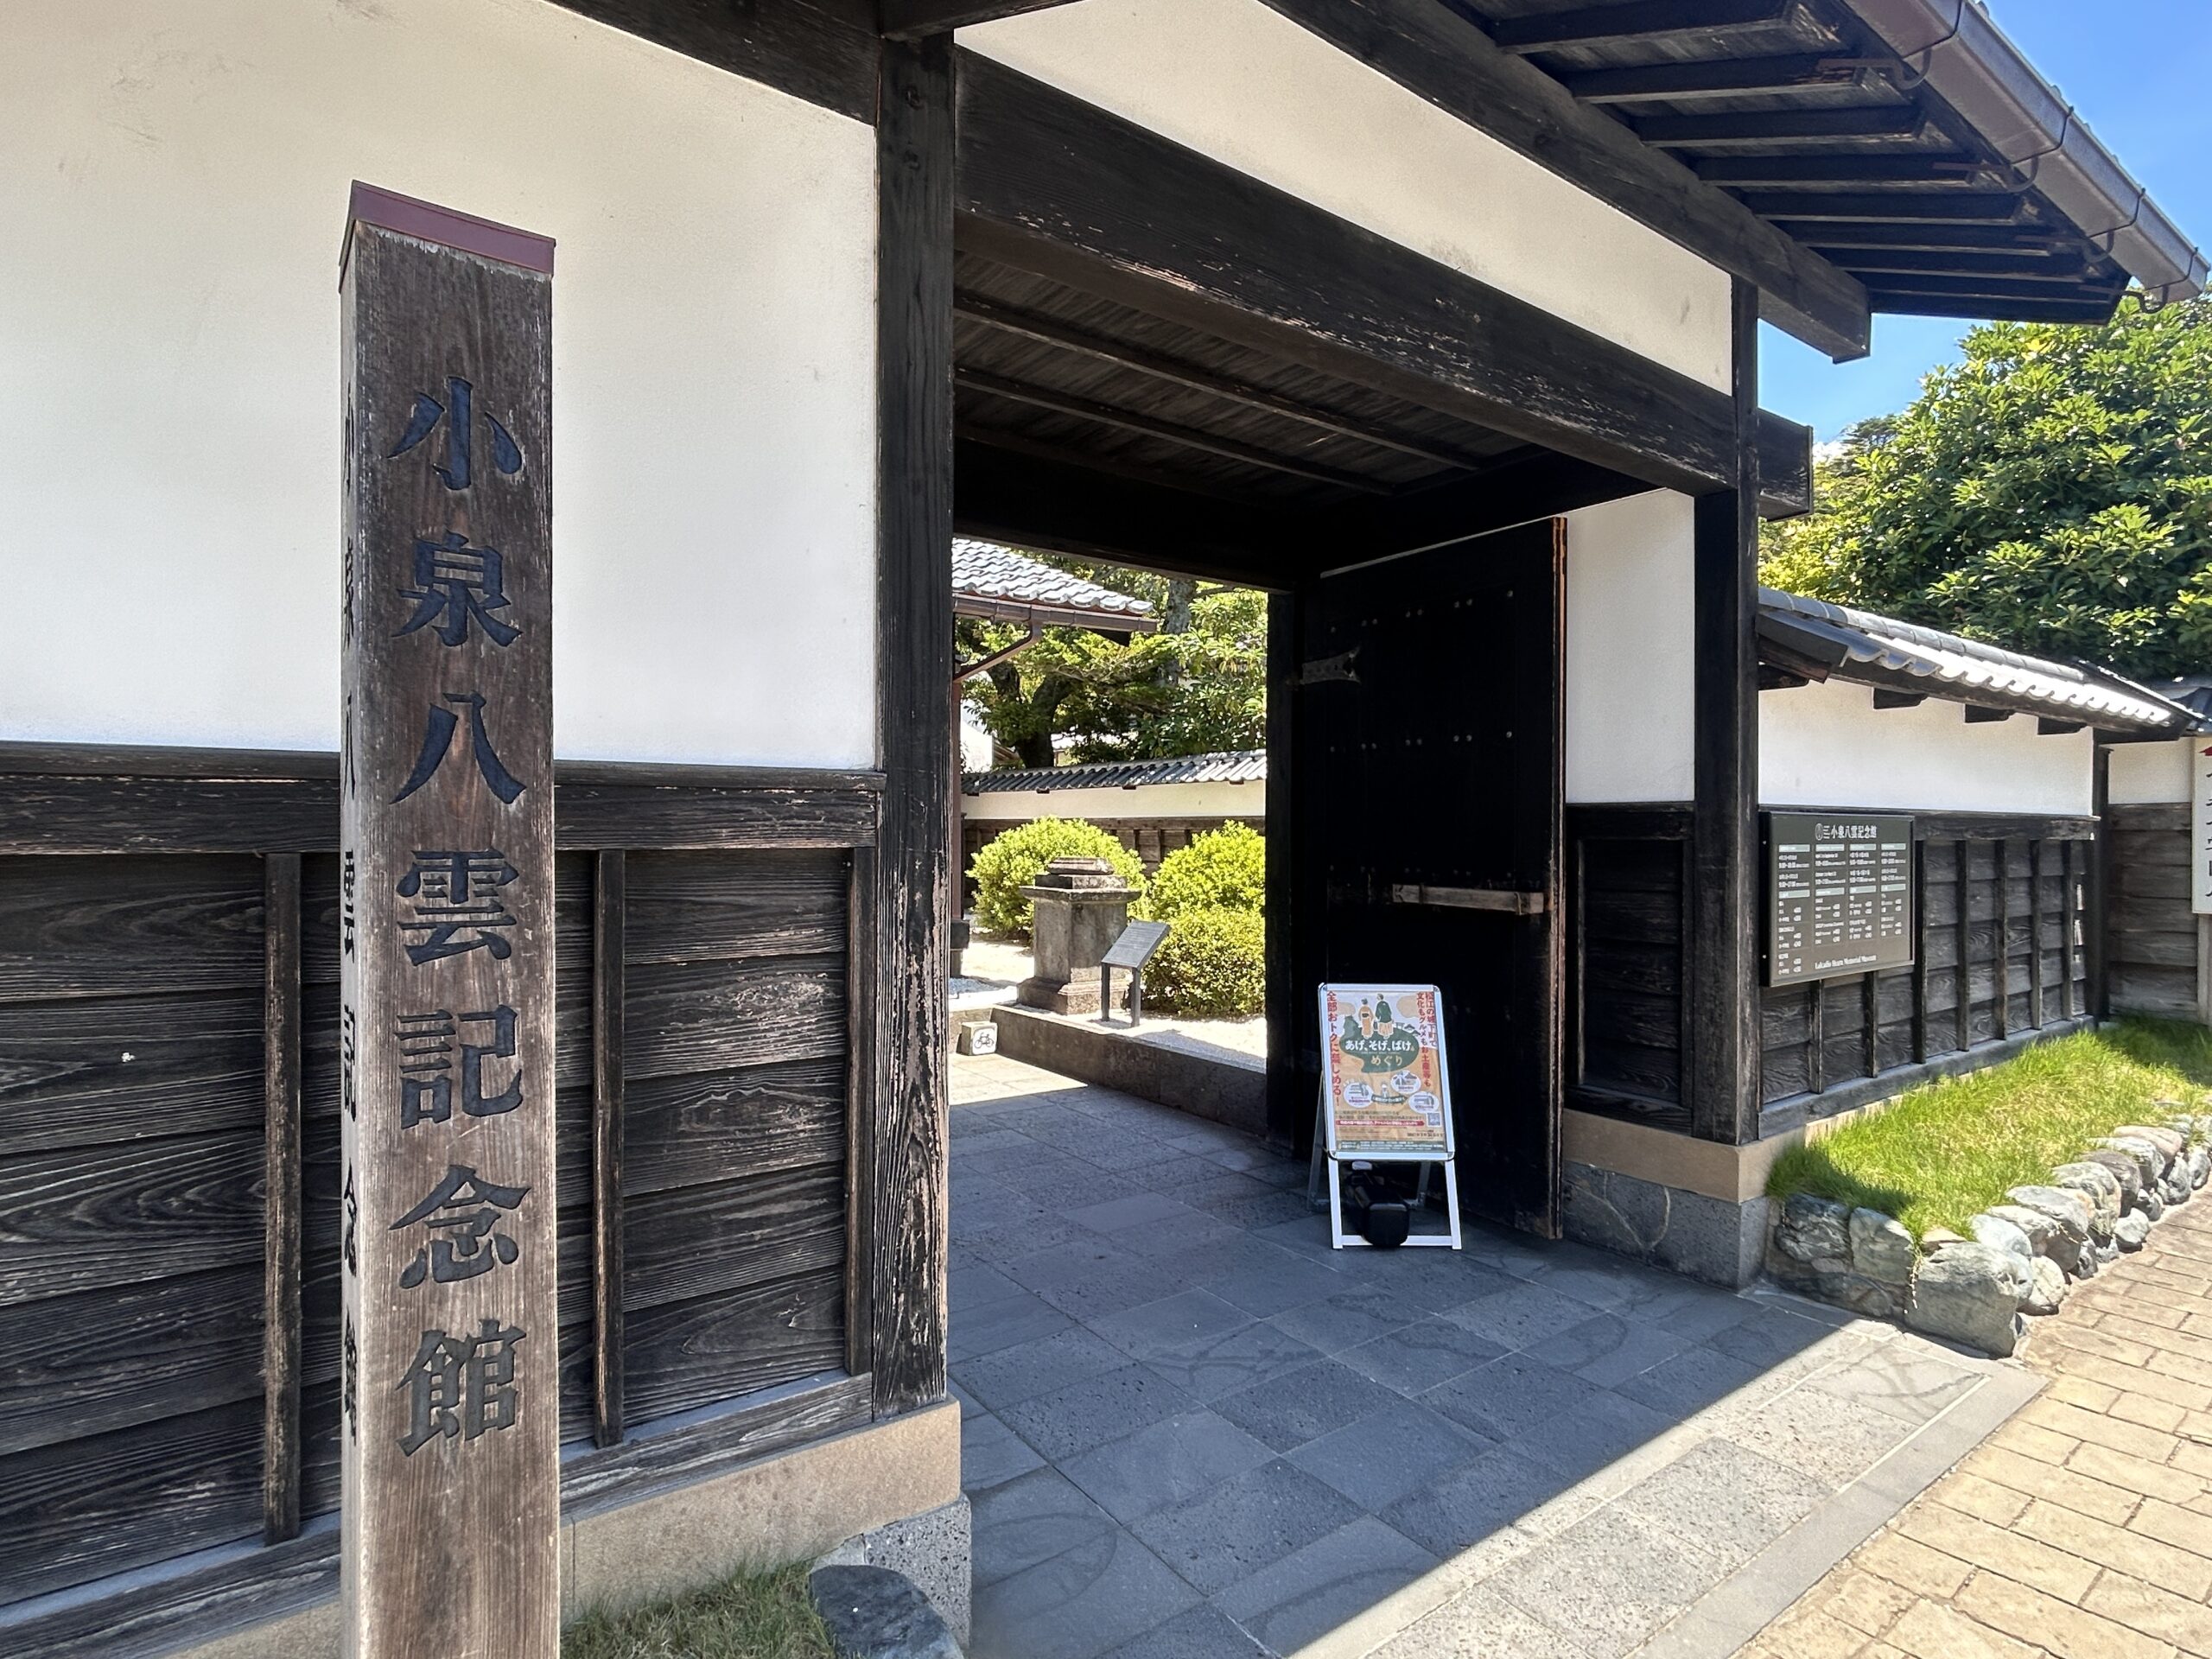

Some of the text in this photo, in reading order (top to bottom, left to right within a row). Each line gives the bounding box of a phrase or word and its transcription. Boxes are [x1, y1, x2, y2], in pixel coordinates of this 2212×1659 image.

[386, 376, 531, 1457] 小泉八雲記念館
[1371, 1055, 1402, 1066] めぐり
